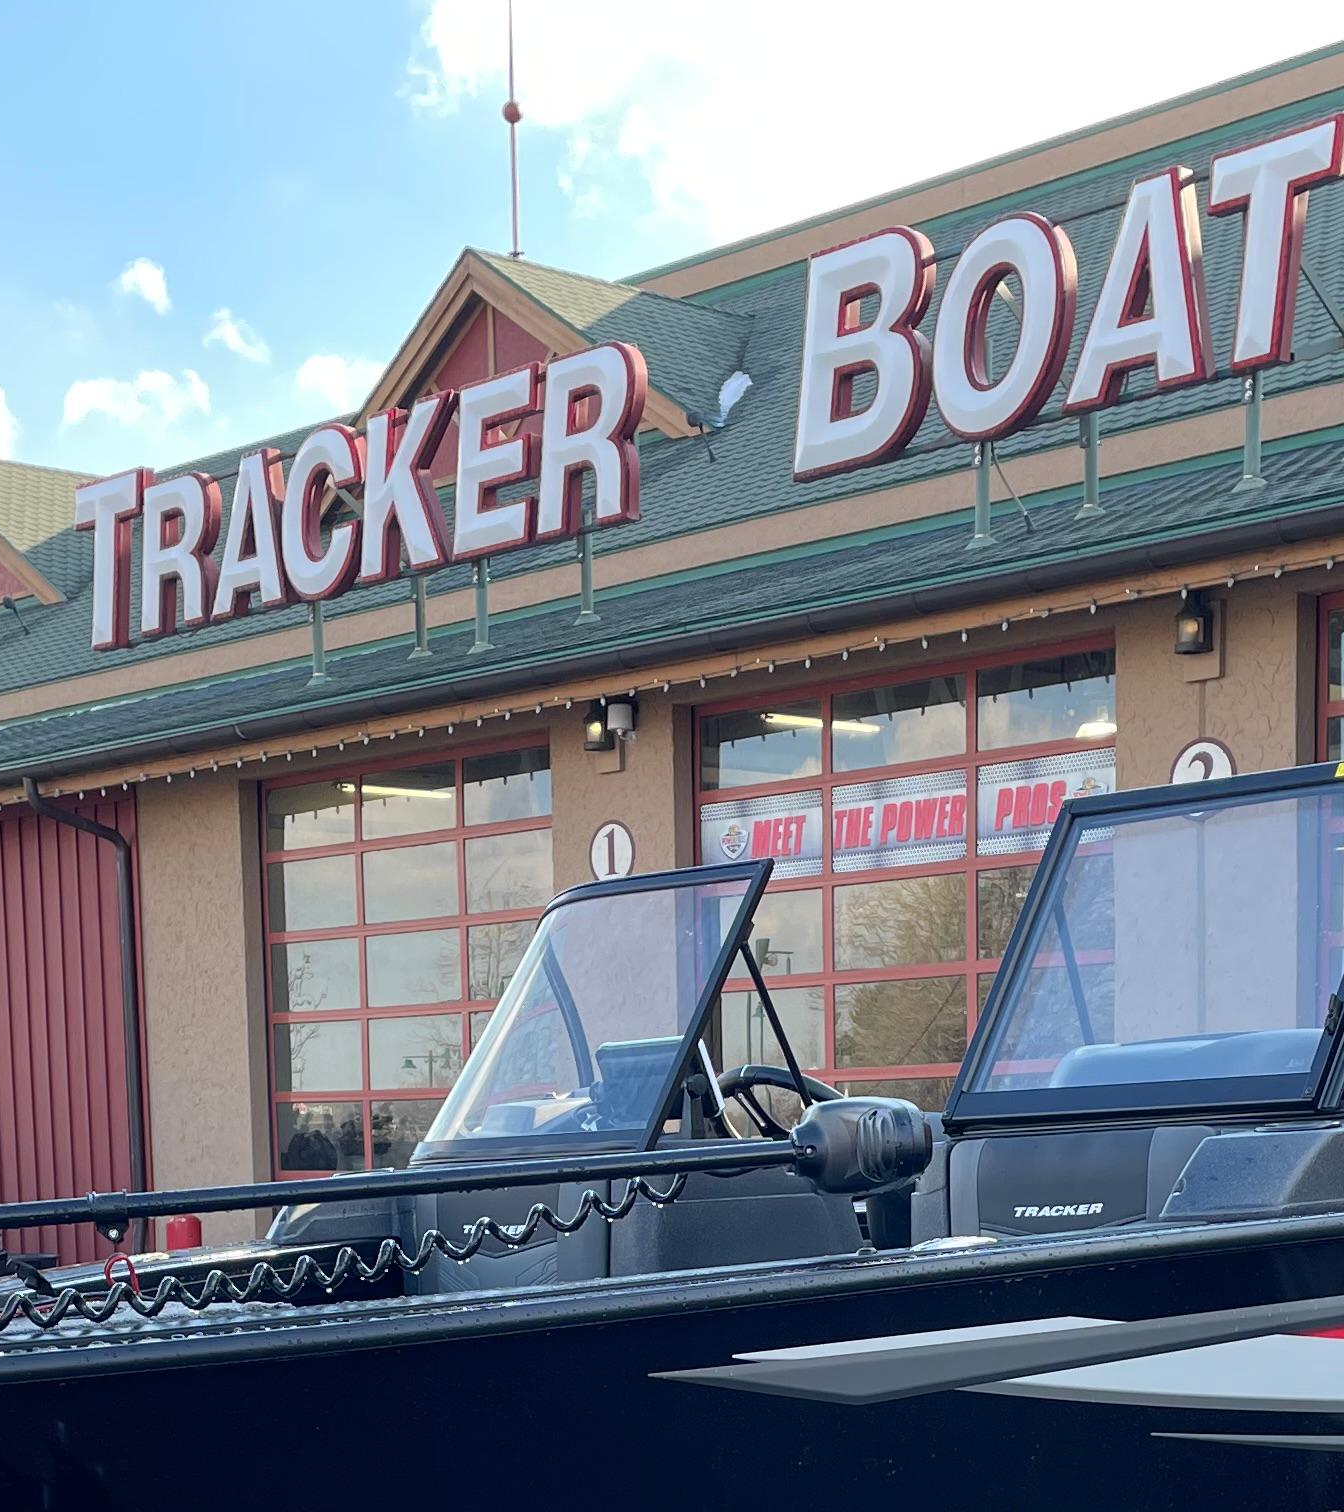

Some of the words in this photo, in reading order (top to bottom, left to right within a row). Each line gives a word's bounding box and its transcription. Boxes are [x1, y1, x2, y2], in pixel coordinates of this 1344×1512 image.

[73, 341, 647, 650] TRACKER
[751, 815, 807, 858] MEET
[834, 801, 874, 849] THE
[880, 794, 967, 845] POWER
[994, 779, 1067, 832] PROS
[603, 827, 621, 876] 1
[1014, 1203, 1104, 1217] TRACKER
